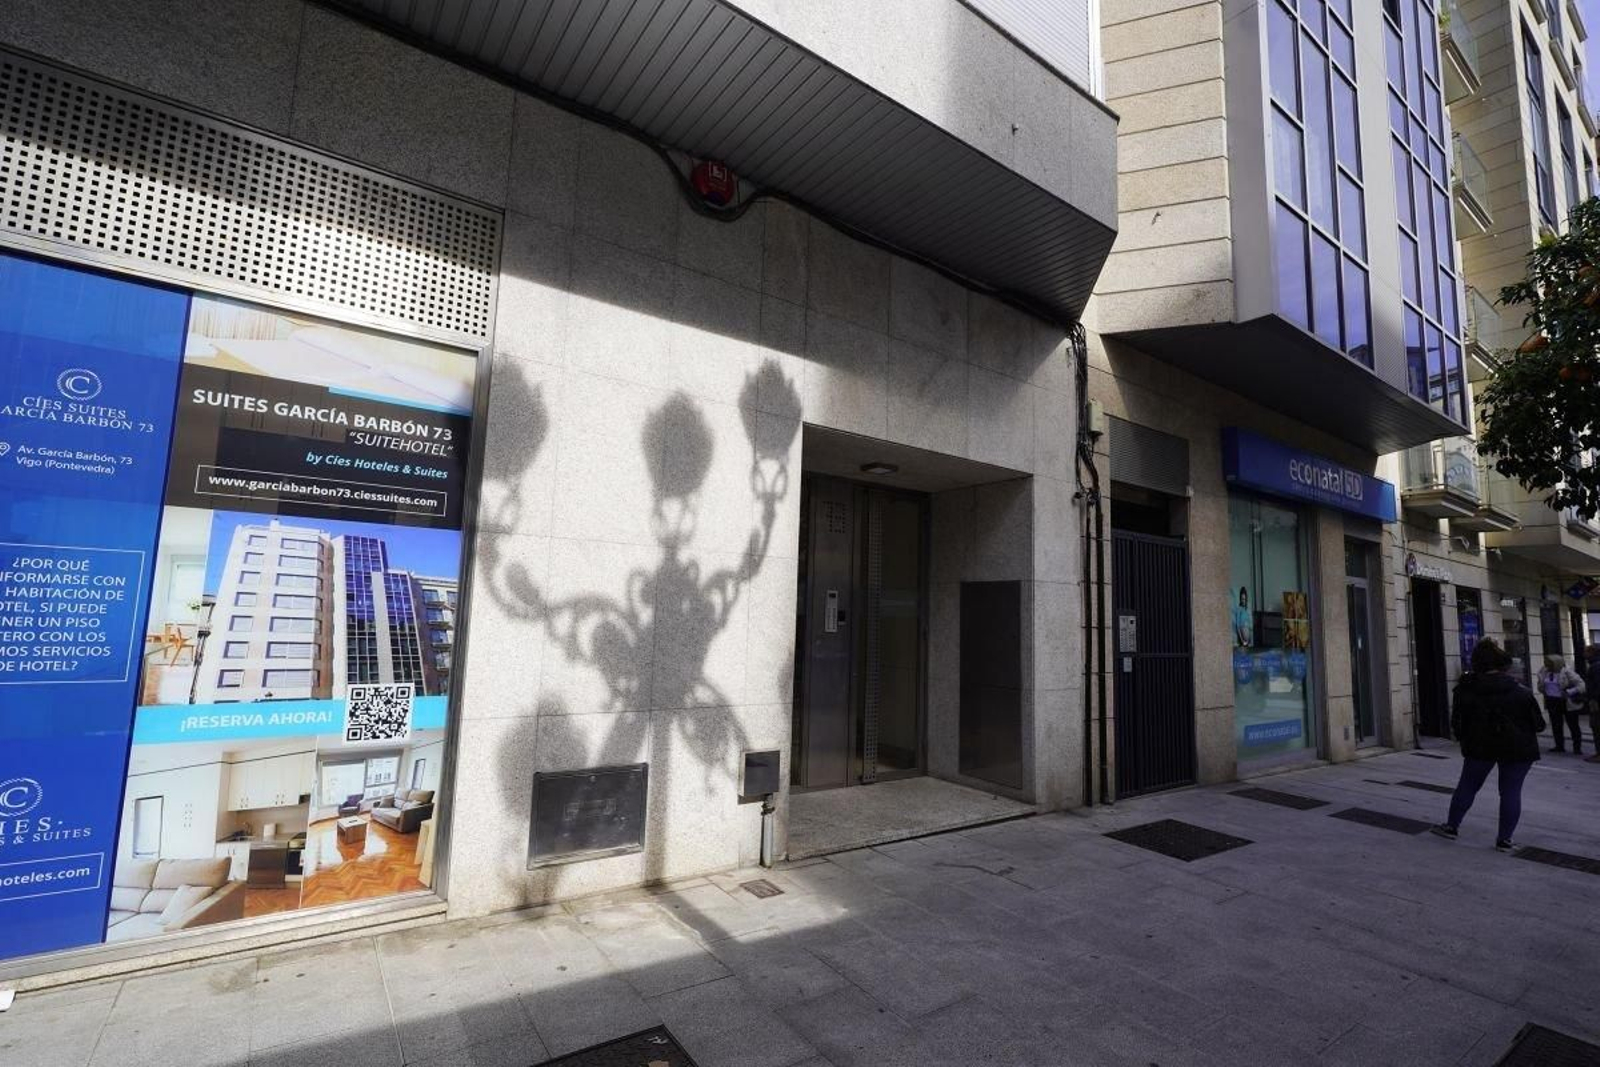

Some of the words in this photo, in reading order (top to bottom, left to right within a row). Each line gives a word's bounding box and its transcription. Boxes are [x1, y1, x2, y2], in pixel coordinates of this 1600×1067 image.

[23, 395, 63, 411] CÍES
[68, 403, 127, 419] SUITES
[193, 389, 268, 413] SUITES
[274, 401, 348, 426] GARCÍA
[353, 414, 429, 438] BARBÓN
[433, 428, 453, 441] 73
[63, 413, 133, 430] BARBÓN
[139, 423, 154, 433] 73
[17, 445, 35, 454] Av.
[38, 447, 73, 459] García
[120, 456, 133, 465] 73
[16, 456, 42, 468] Vigo
[45, 459, 115, 475] (Pontevedra)
[306, 452, 323, 465] by
[354, 458, 399, 474] Hoteles
[402, 464, 412, 474] &
[414, 465, 448, 479] Suites
[1289, 458, 1344, 495] econatal
[208, 475, 438, 508] www.garciabarbon73.ciessuites.com
[12, 557, 54, 569] ¿POR
[57, 559, 90, 572] QUÉ
[93, 575, 126, 586] CON
[5, 586, 101, 600] HABITACIÓN
[105, 590, 125, 601] DE
[39, 602, 53, 613] SI
[57, 603, 108, 614] PUEDE
[0, 616, 34, 627] NER
[38, 617, 61, 627] UN
[65, 617, 100, 628] PISO
[39, 632, 74, 642] CON
[78, 632, 106, 642] LOS
[32, 646, 112, 657] SERVICIOS
[19, 660, 78, 671] HOTEL?
[180, 713, 264, 732] ¡RESERVA
[268, 711, 333, 725] AHORA!
[13, 835, 25, 845] &
[32, 827, 92, 842] SUITES
[0, 867, 90, 887] oteles.com
